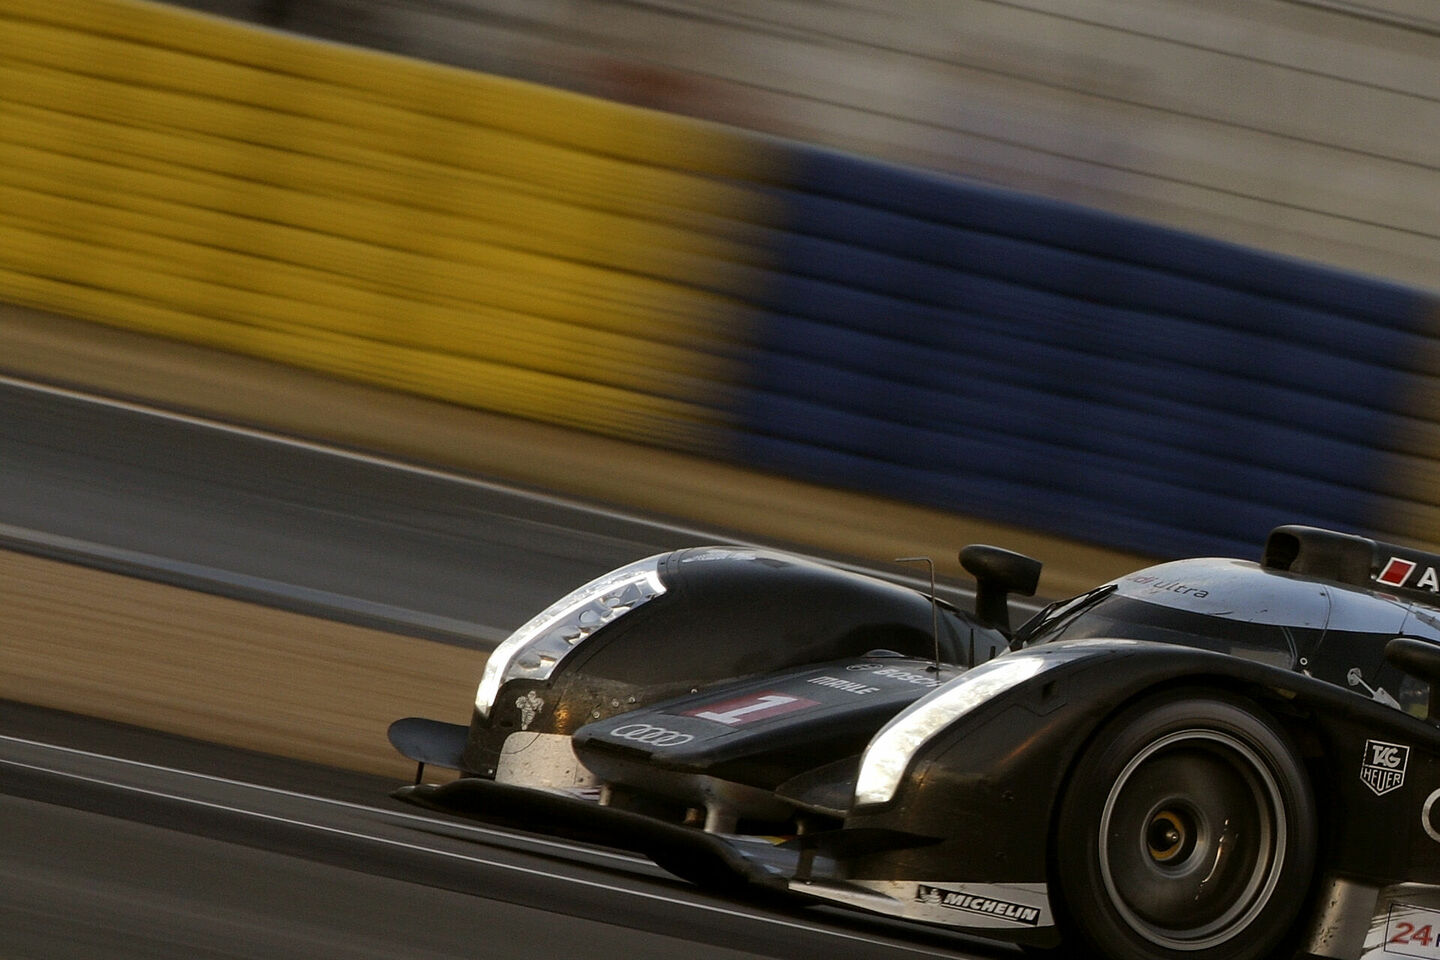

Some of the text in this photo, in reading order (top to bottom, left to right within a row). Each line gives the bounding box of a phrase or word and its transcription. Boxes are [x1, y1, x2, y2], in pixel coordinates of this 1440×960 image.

[1153, 582, 1209, 599] ultra
[807, 675, 880, 695] MAHLE
[872, 668, 944, 688] BOSCH
[695, 694, 798, 724] 1
[1372, 745, 1401, 768] TAG
[1363, 767, 1401, 791] HEUER
[943, 893, 1038, 921] MICHELIN
[1390, 922, 1433, 947] 24
